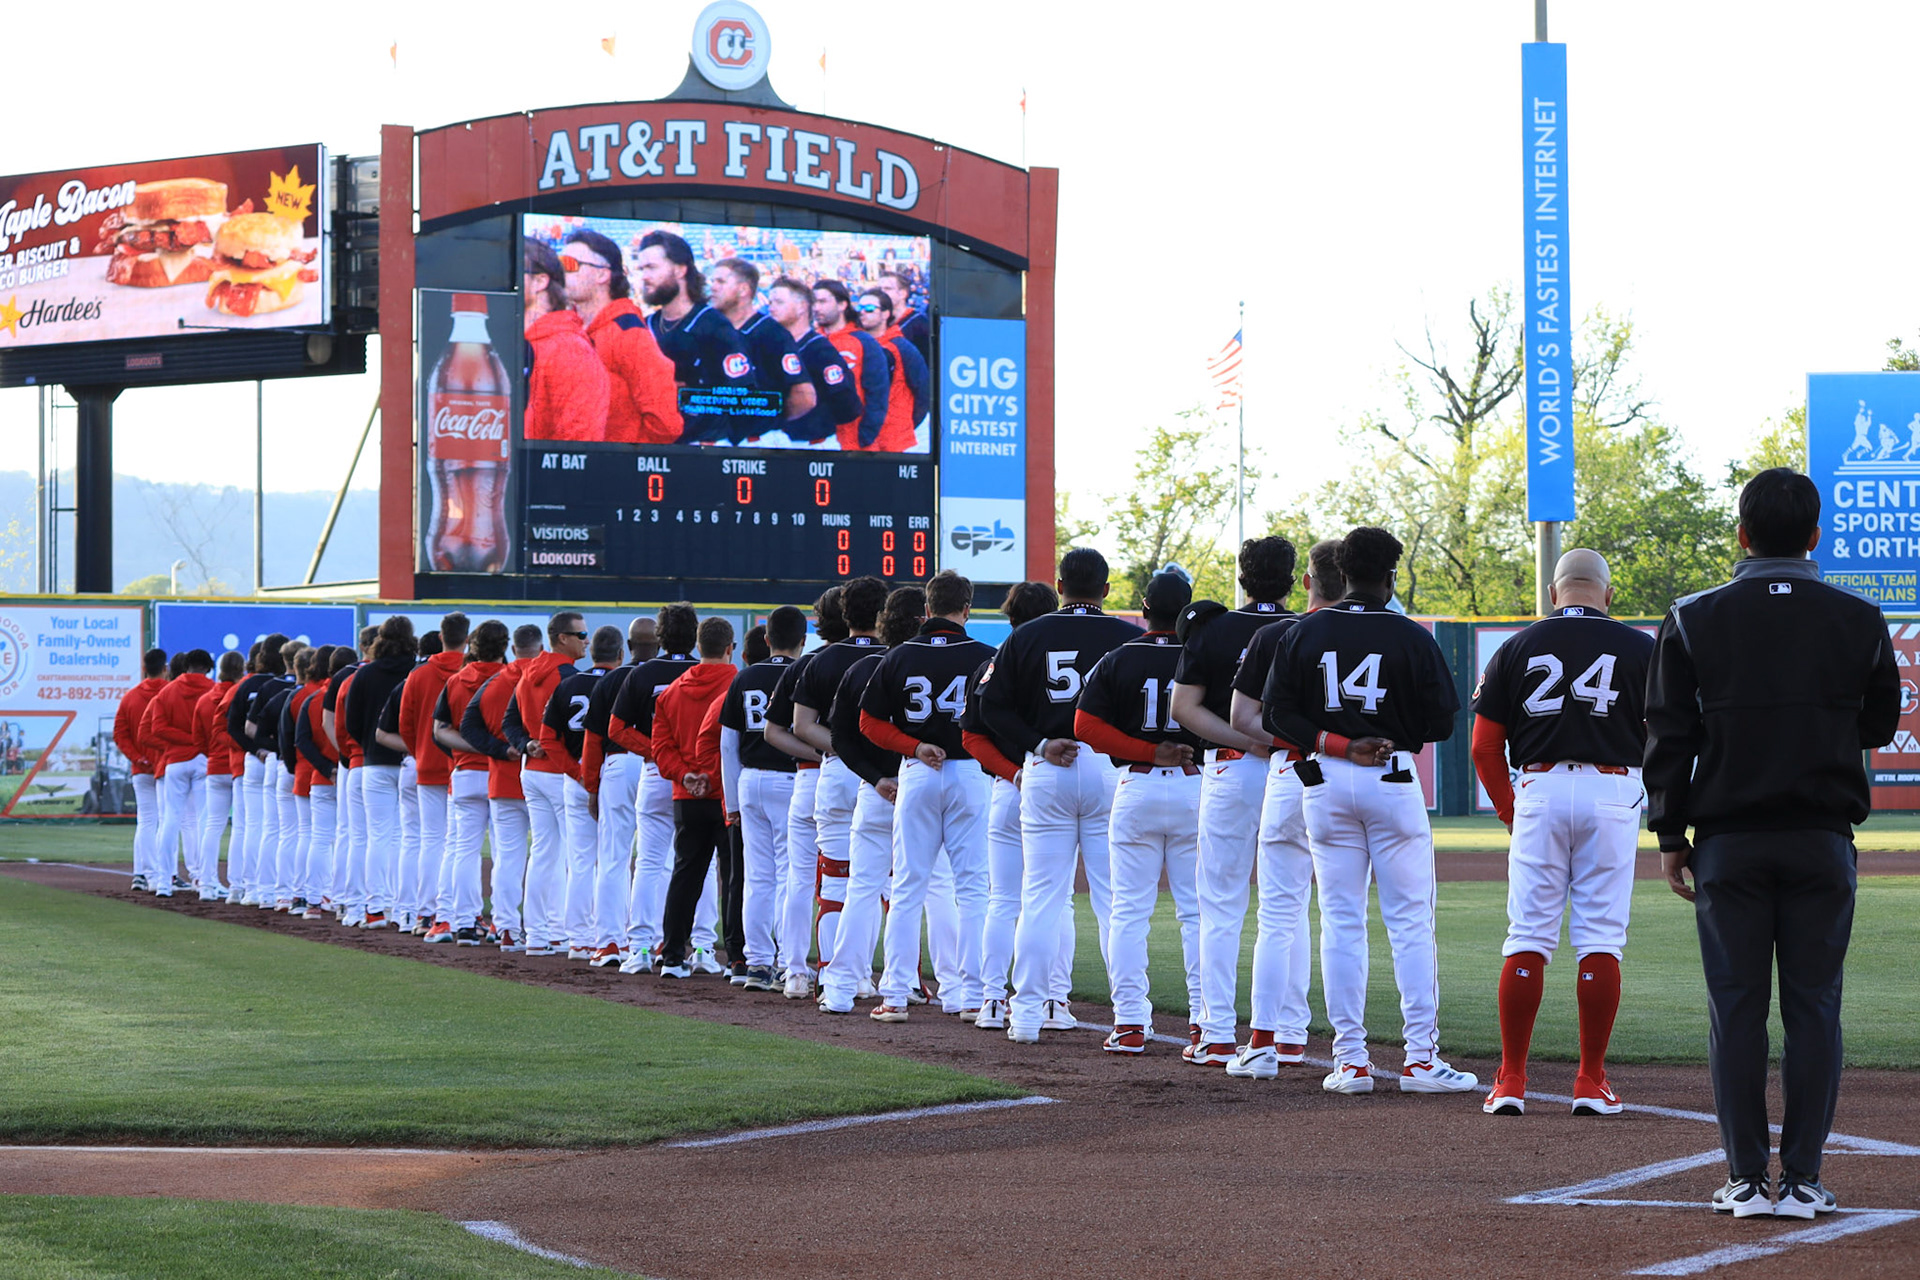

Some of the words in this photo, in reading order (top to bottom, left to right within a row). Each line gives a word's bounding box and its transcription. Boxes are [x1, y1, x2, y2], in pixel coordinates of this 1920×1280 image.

[538, 120, 706, 191] AT&T
[723, 120, 920, 211] FIELD
[1533, 97, 1558, 221] INTERNET
[54, 180, 136, 226] Bacon
[276, 190, 303, 210] NEW
[16, 241, 67, 268] BISCUIT
[19, 258, 69, 286] BURGER
[1535, 230, 1560, 334] FASTEST
[19, 297, 103, 329] Hardee's
[949, 355, 1018, 390] GIG
[949, 394, 1018, 416] CITY'S
[1537, 343, 1562, 466] WORLD'S
[434, 406, 505, 440] Coca-Cola
[950, 419, 1018, 437] FASTEST
[950, 441, 1017, 456] INTERNET
[541, 453, 558, 469] AT
[562, 454, 587, 470] BAT
[637, 456, 671, 473] BALL
[722, 459, 766, 476] STRIKE
[809, 461, 834, 477] OUT
[899, 465, 918, 479] H/E
[648, 474, 664, 502] 0
[736, 476, 752, 504] 0
[815, 478, 830, 506] 0
[1833, 480, 1920, 508] CENT
[616, 508, 623, 521] 1
[633, 509, 641, 522] 2
[651, 509, 659, 522] 3
[676, 510, 684, 522] 4
[693, 510, 702, 523] 5
[711, 511, 719, 523] 6
[735, 511, 742, 524] 7
[753, 511, 761, 524] 8
[771, 512, 778, 525] 9
[792, 513, 805, 526] 10
[822, 514, 851, 527] RUNS
[869, 515, 893, 528] HITS
[908, 516, 930, 529] ERR
[1833, 512, 1920, 533] SPORTS
[532, 526, 589, 540] VISITORS
[837, 529, 850, 551] 0
[882, 530, 895, 552] 0
[913, 531, 926, 553] 0
[532, 552, 596, 566] LOOKOUTS
[1833, 538, 1851, 558] &
[1857, 537, 1920, 558] ORTH
[837, 554, 850, 576] 0
[882, 555, 895, 577] 0
[913, 556, 926, 577] 0
[1823, 574, 1880, 586] OFFICIAL
[1881, 574, 1917, 586] TEAM
[50, 616, 79, 630] Your
[84, 616, 118, 630] Local
[37, 633, 131, 650] Family-Owned
[49, 652, 119, 668] Dealership
[1317, 650, 1388, 715] 14
[1522, 653, 1620, 718] 24
[903, 675, 968, 723] 34
[1141, 677, 1182, 733] 11
